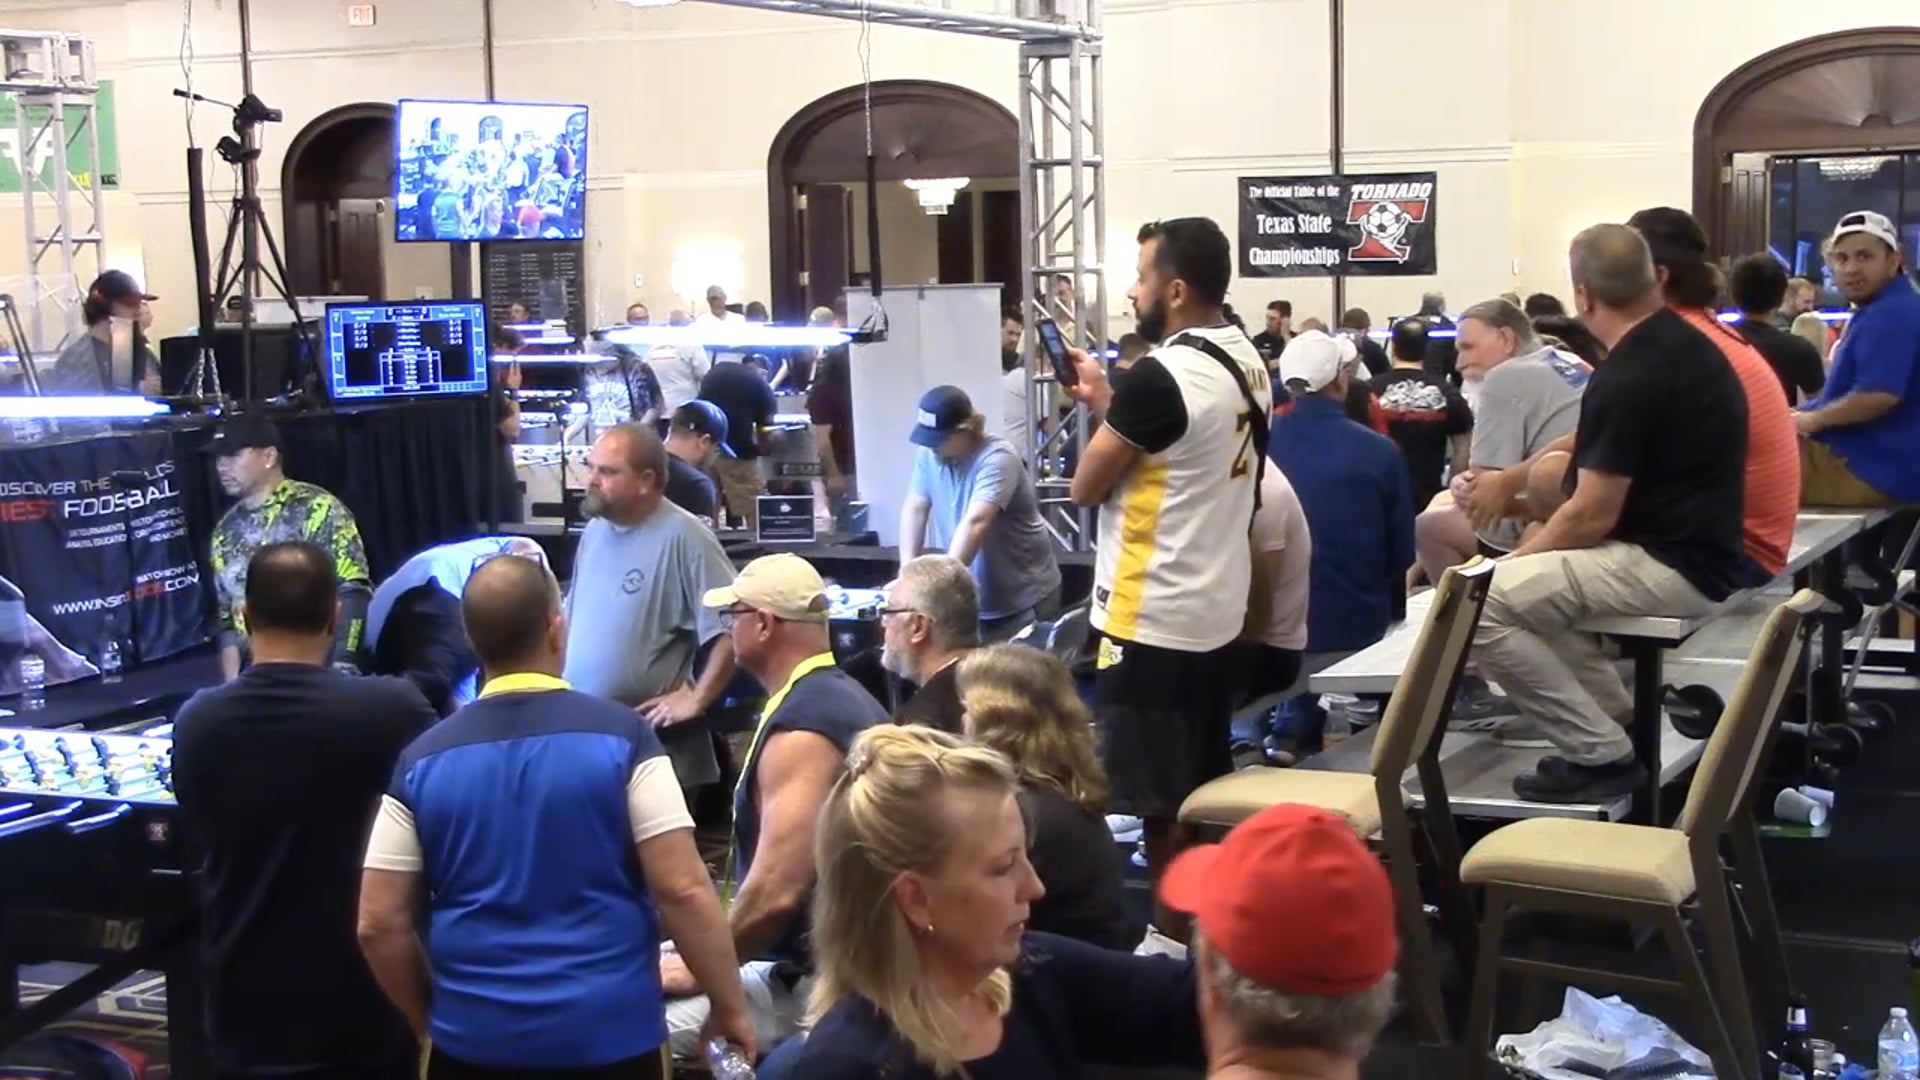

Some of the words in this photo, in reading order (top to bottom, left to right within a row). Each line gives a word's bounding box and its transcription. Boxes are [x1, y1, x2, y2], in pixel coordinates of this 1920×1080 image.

[1249, 186, 1263, 198] The
[1264, 185, 1293, 198] Official
[1294, 185, 1315, 197] Table
[1317, 185, 1325, 197] of
[1327, 184, 1340, 197] the
[1351, 182, 1432, 199] TORNADO
[1256, 214, 1295, 234] Texas
[1297, 213, 1332, 233] State
[1249, 247, 1340, 267] Championships
[80, 477, 112, 492] THE
